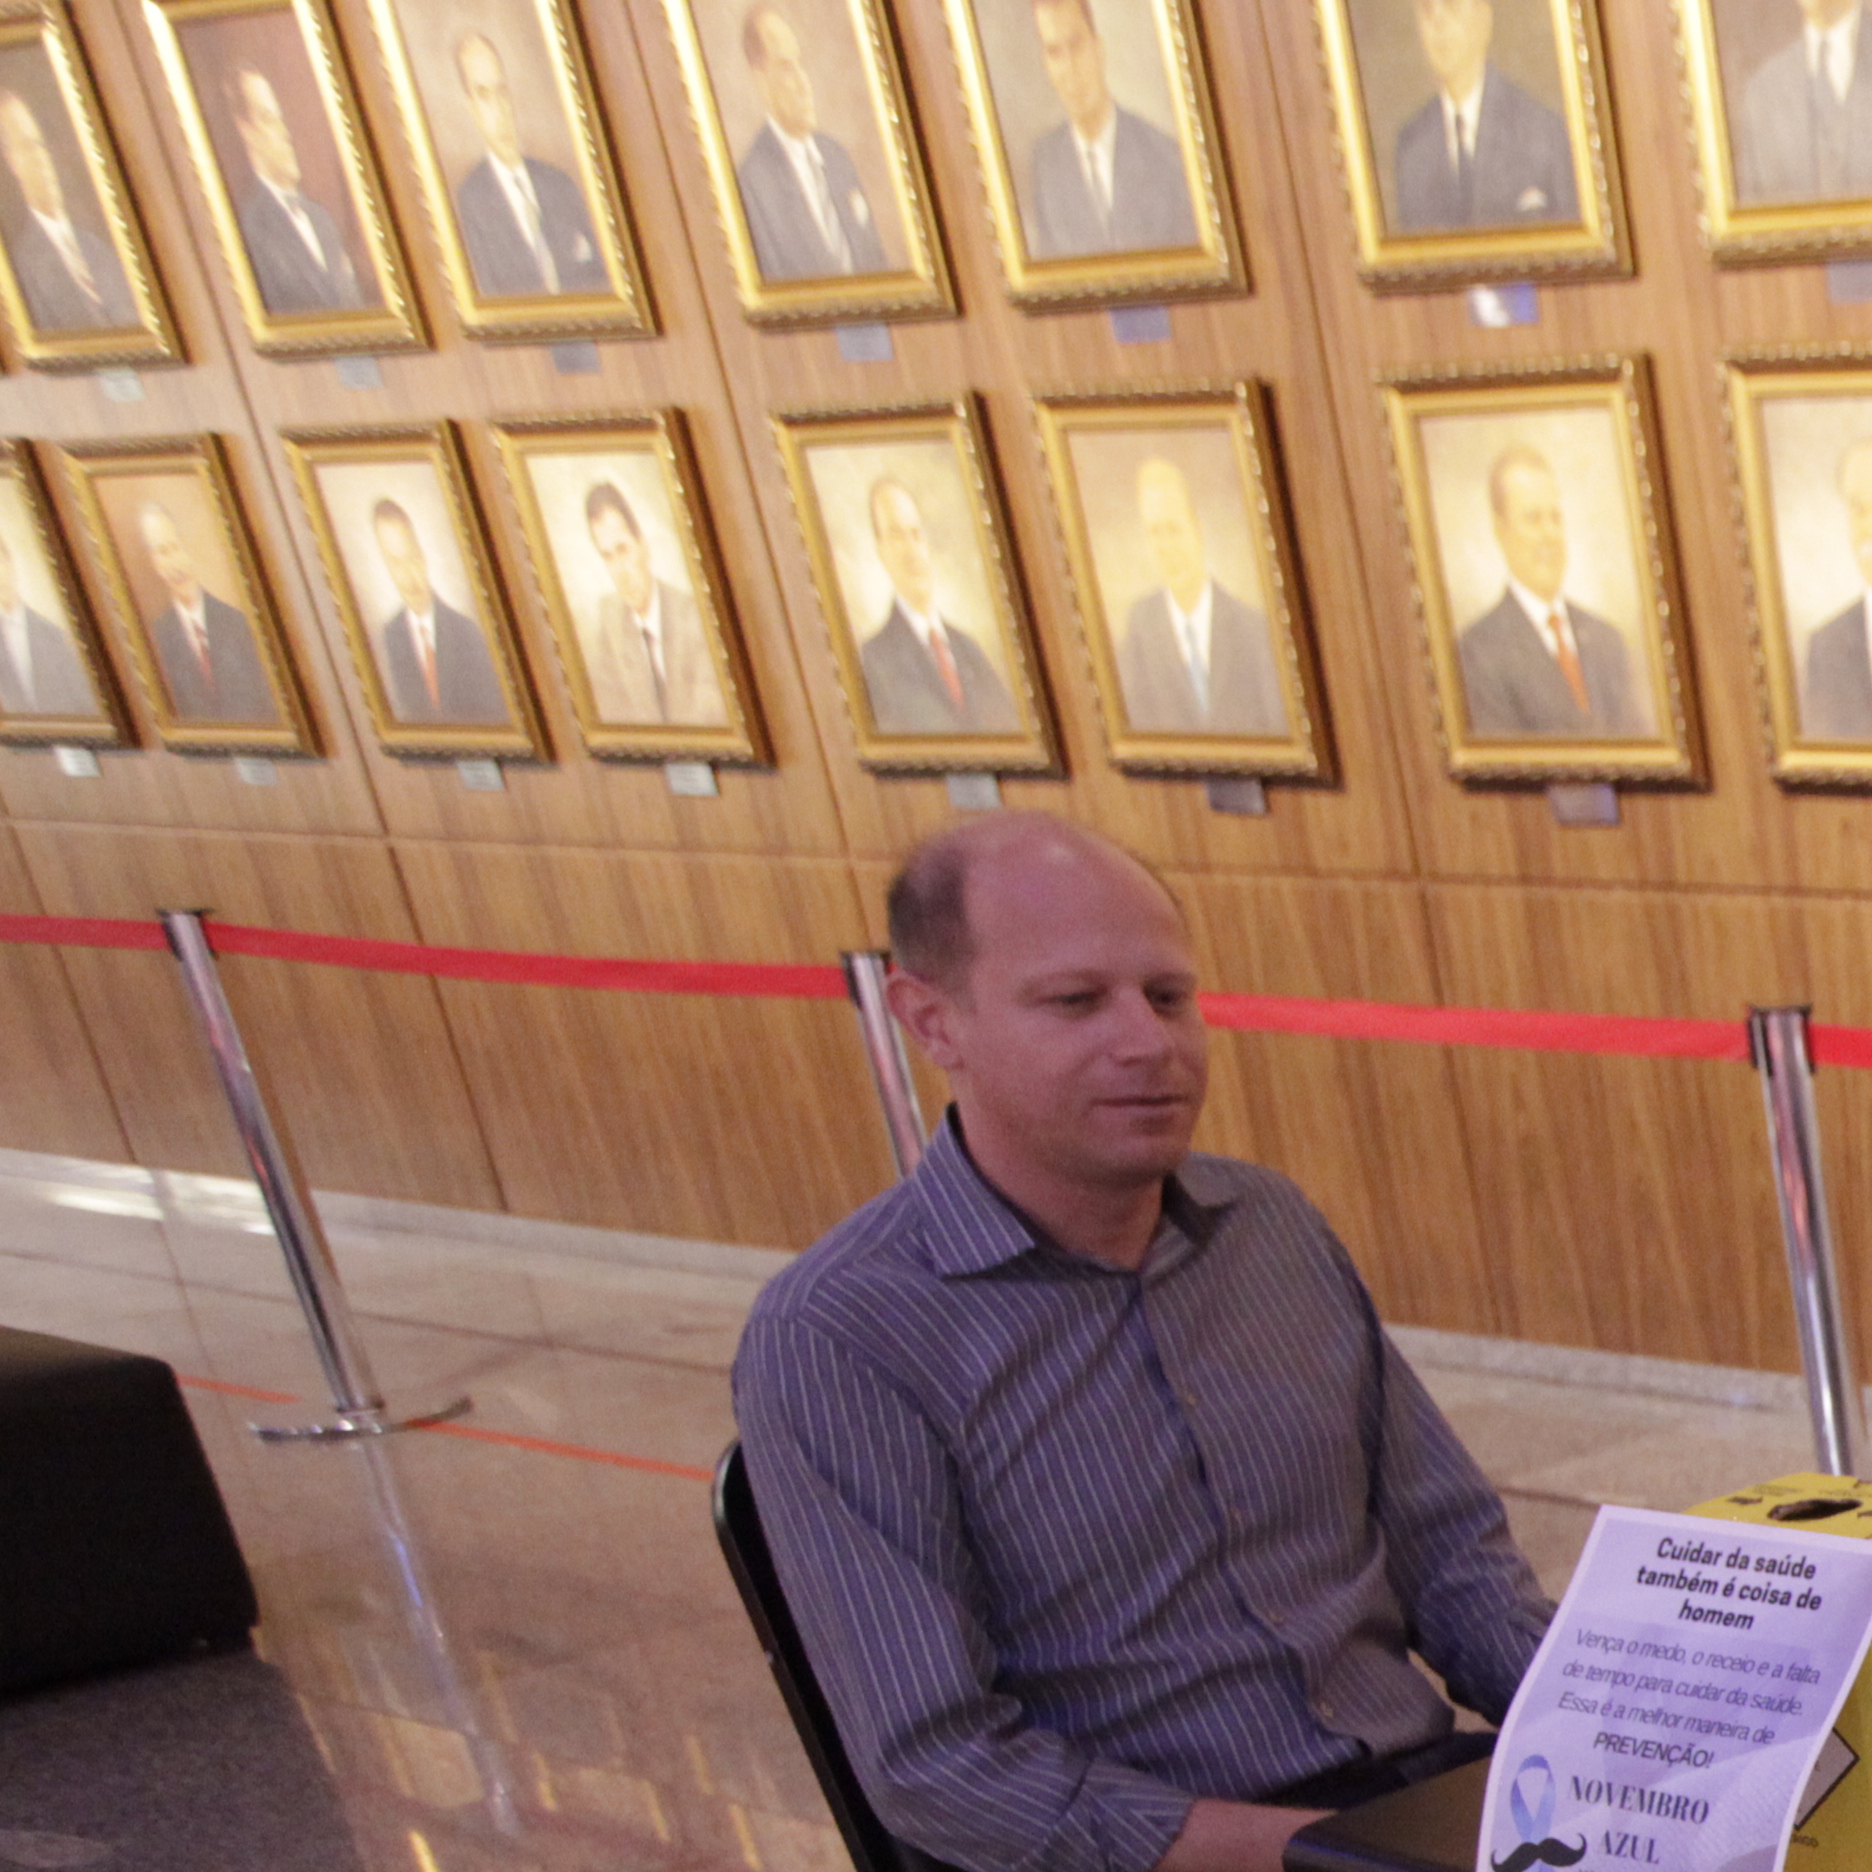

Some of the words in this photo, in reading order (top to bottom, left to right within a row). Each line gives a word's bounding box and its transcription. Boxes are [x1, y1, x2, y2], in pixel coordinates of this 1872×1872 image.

[1656, 1537, 1722, 1568] Cuidar
[1726, 1547, 1750, 1571] da
[1753, 1552, 1817, 1580] saúde
[1636, 1565, 1717, 1597] também
[1722, 1577, 1735, 1598] é
[1738, 1581, 1792, 1607] coisa
[1796, 1587, 1822, 1611] de
[1678, 1598, 1755, 1631] homem
[1575, 1628, 1624, 1654] Vença
[1626, 1639, 1638, 1655] o
[1638, 1638, 1687, 1667] medo,
[1692, 1650, 1704, 1667] o
[1704, 1650, 1755, 1675] receio
[1757, 1660, 1770, 1677] e
[1771, 1663, 1783, 1680] a
[1783, 1662, 1822, 1686] falta
[1562, 1659, 1585, 1679] de
[1585, 1664, 1635, 1690] tempo
[1635, 1673, 1673, 1696] para
[1674, 1679, 1725, 1704] cuidar
[1725, 1686, 1748, 1706] da
[1749, 1689, 1804, 1717] saúde.
[1557, 1690, 1597, 1716] Essa
[1599, 1696, 1613, 1717] é
[1613, 1703, 1626, 1720] a
[1627, 1704, 1681, 1730] melhor
[1684, 1714, 1751, 1743] maneira
[1752, 1724, 1776, 1746] de
[1592, 1731, 1716, 1769] PREVENÇÃO!
[1569, 1775, 1710, 1826] NOVEMBRO
[1600, 1829, 1661, 1866] AZUL
